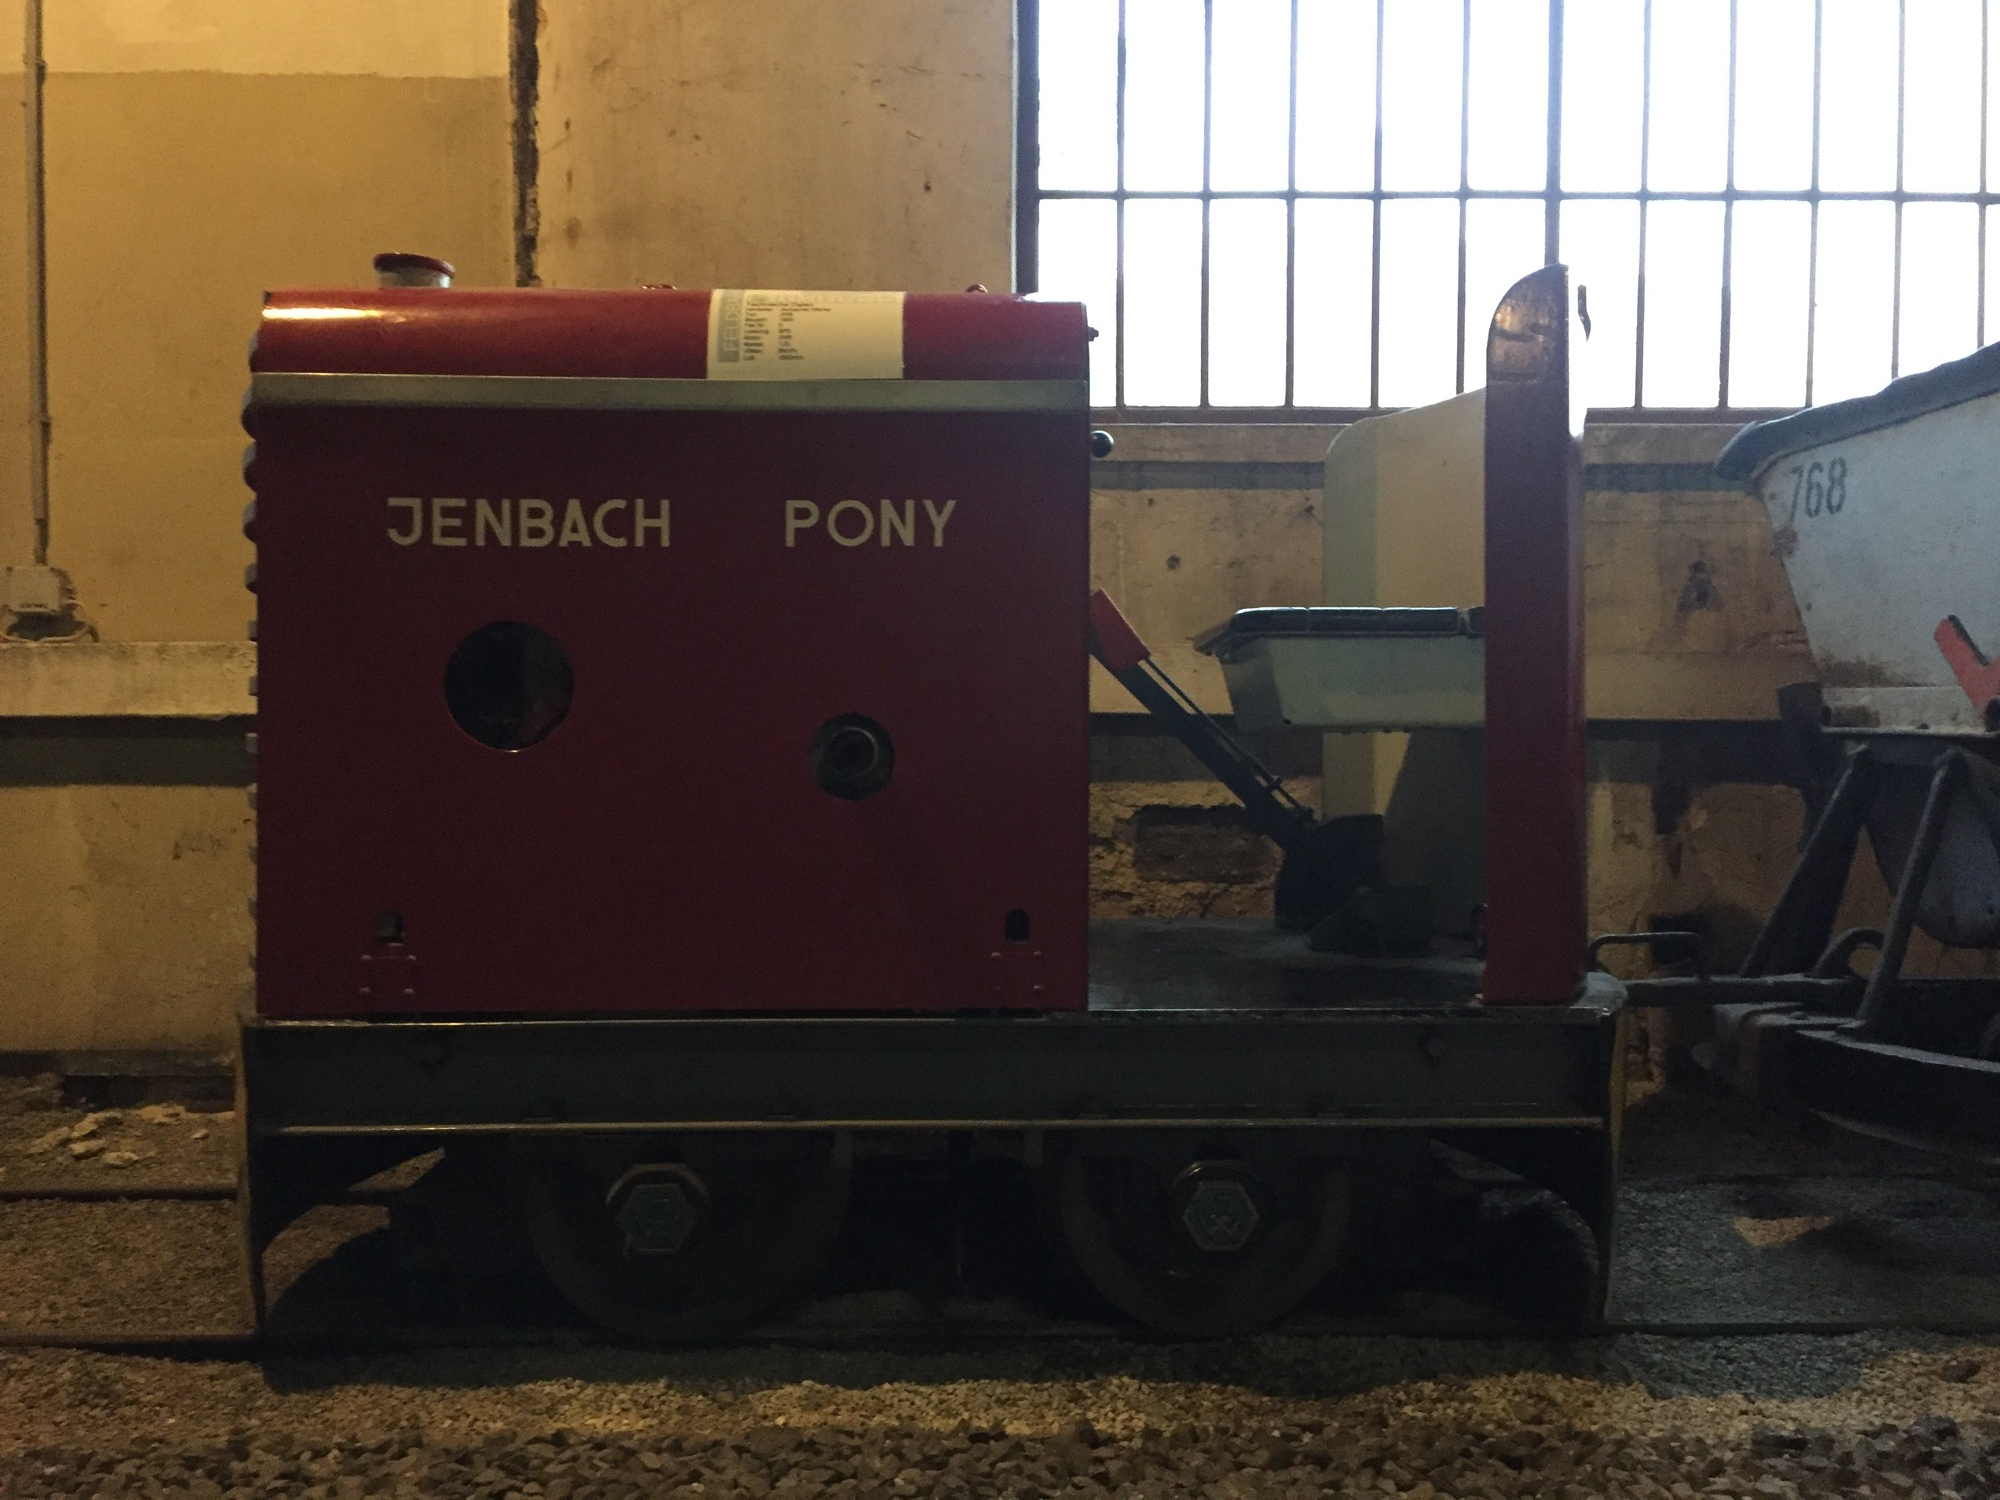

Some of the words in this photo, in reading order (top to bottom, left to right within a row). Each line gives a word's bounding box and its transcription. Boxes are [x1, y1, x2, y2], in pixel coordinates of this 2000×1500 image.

[1791, 457, 1848, 522] 768
[386, 498, 671, 548] JENBACH
[784, 498, 957, 548] PONY
